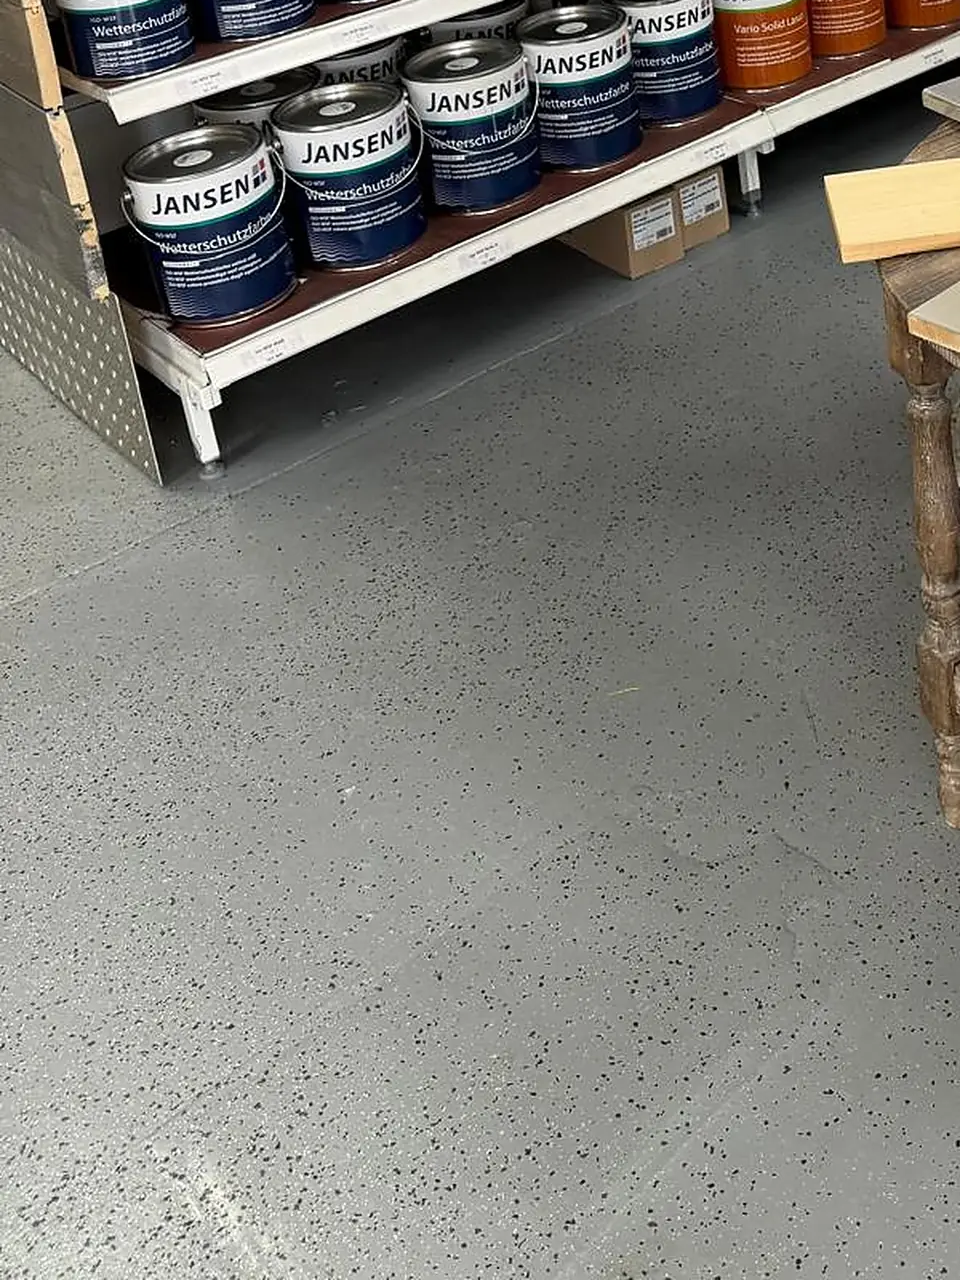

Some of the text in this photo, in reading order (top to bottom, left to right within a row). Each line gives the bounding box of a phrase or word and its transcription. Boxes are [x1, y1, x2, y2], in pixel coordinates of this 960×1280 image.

[628, 6, 699, 34] JANSEN
[734, 21, 760, 34] Vario
[761, 19, 784, 32] Solid
[536, 46, 614, 74] JANSEN
[426, 80, 512, 113] JANSEN
[302, 125, 393, 164] JANSEN
[152, 174, 250, 215] JANSEN
[159, 212, 272, 254] Wetterschutzfarbe
